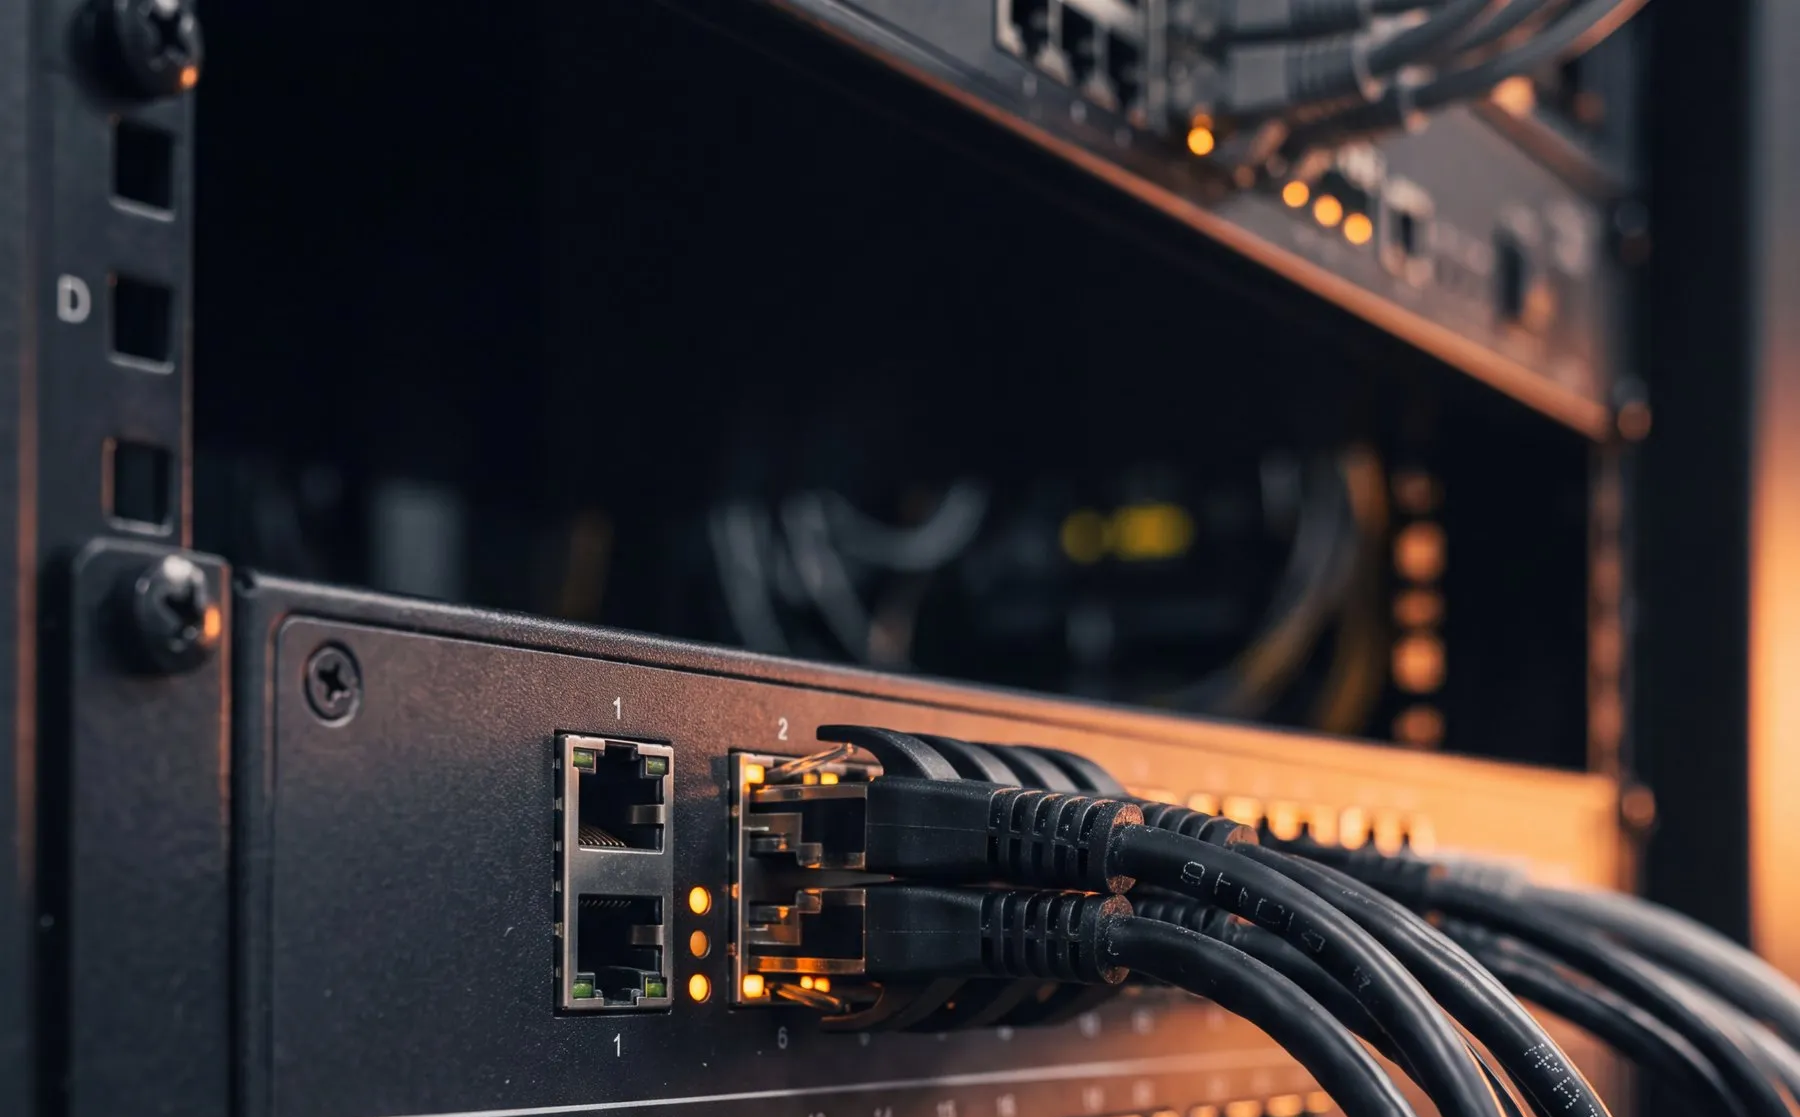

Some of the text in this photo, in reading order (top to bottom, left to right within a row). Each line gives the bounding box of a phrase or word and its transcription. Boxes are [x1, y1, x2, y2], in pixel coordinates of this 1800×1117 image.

[57, 273, 91, 323] D
[612, 696, 621, 720] 1
[778, 717, 788, 740] 2
[613, 1033, 621, 1058] 1
[777, 1026, 788, 1050] 6
